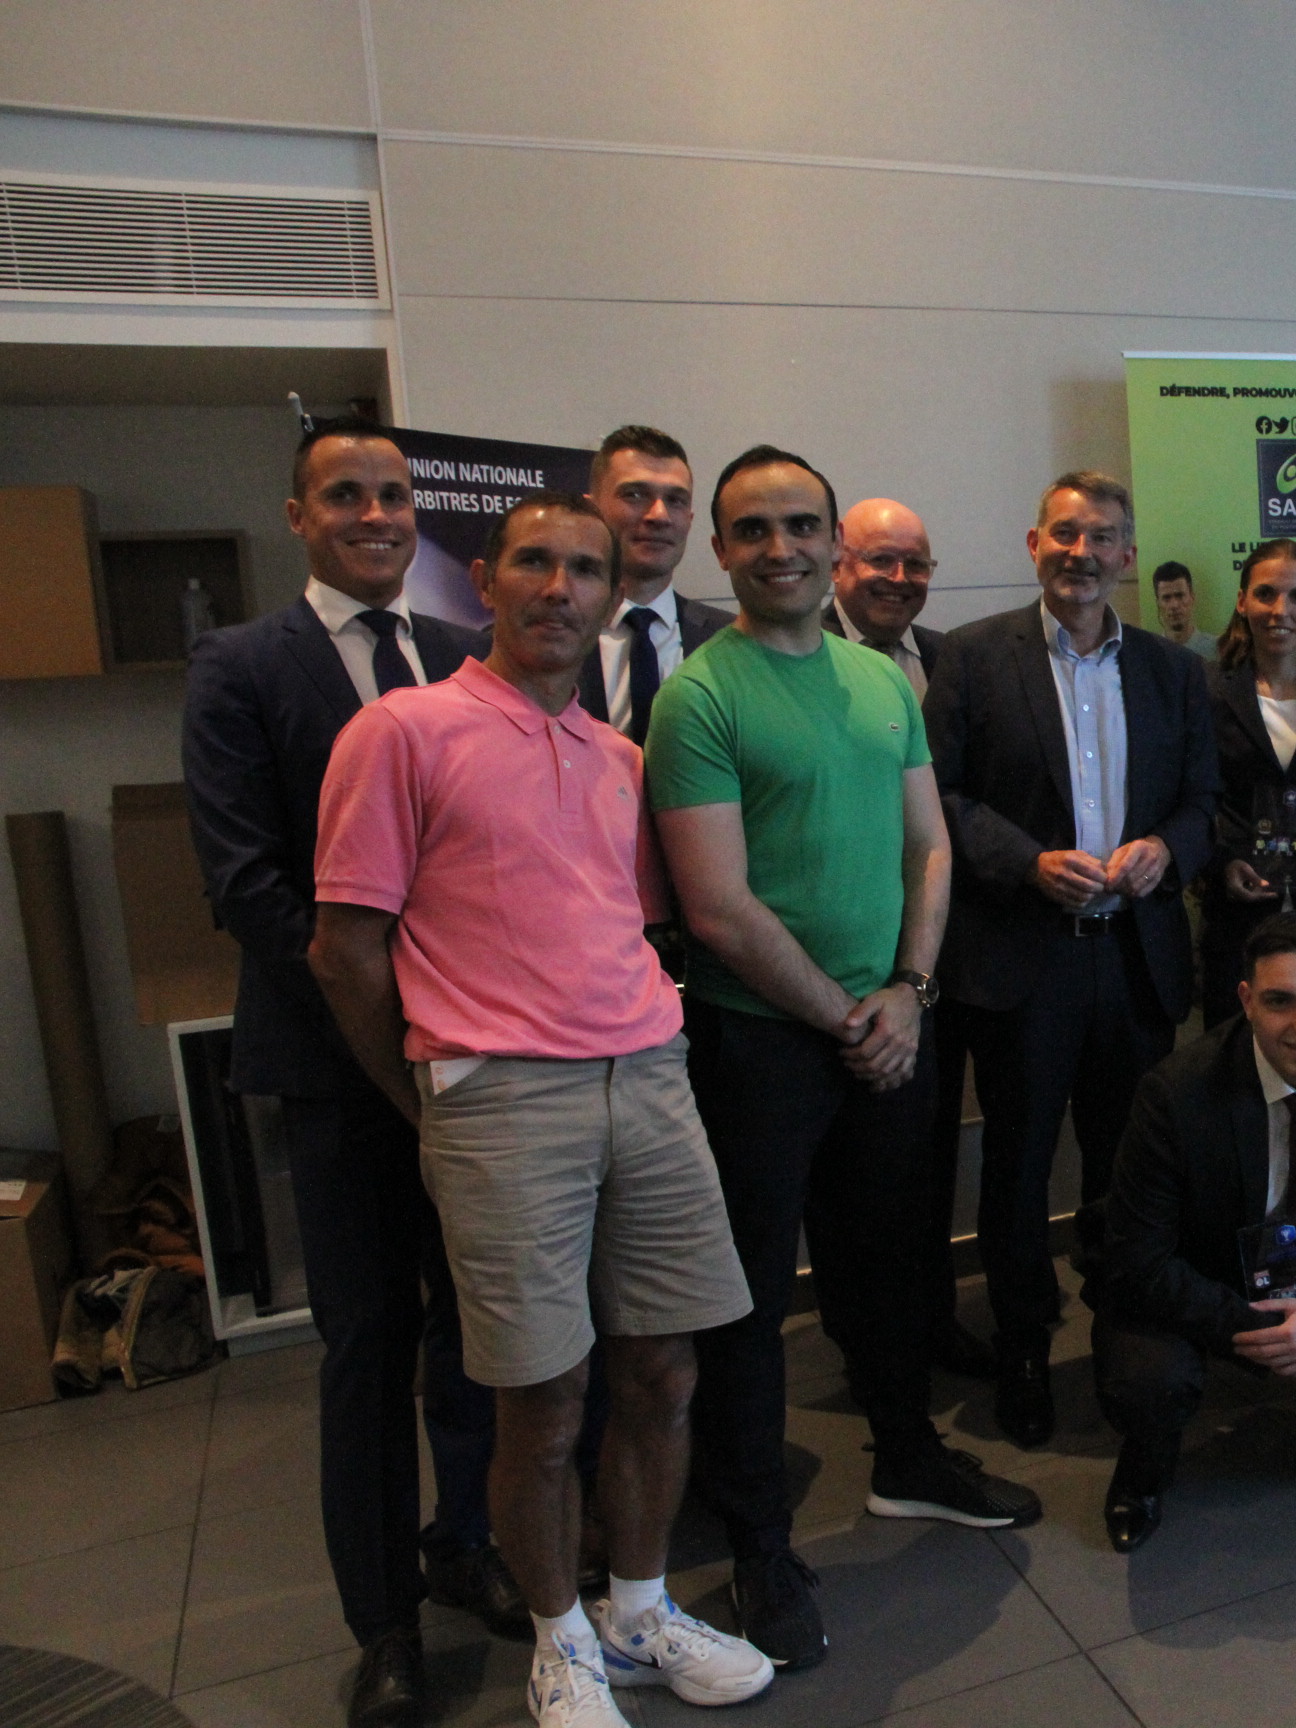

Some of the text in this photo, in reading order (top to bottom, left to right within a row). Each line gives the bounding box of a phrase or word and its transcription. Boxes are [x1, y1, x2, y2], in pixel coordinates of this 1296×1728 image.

[1160, 384, 1230, 399] DÉFENDRE,
[459, 462, 545, 488] NATIONALE
[412, 489, 479, 512] RBITRES
[481, 494, 504, 515] DE
[1232, 542, 1246, 553] LE
